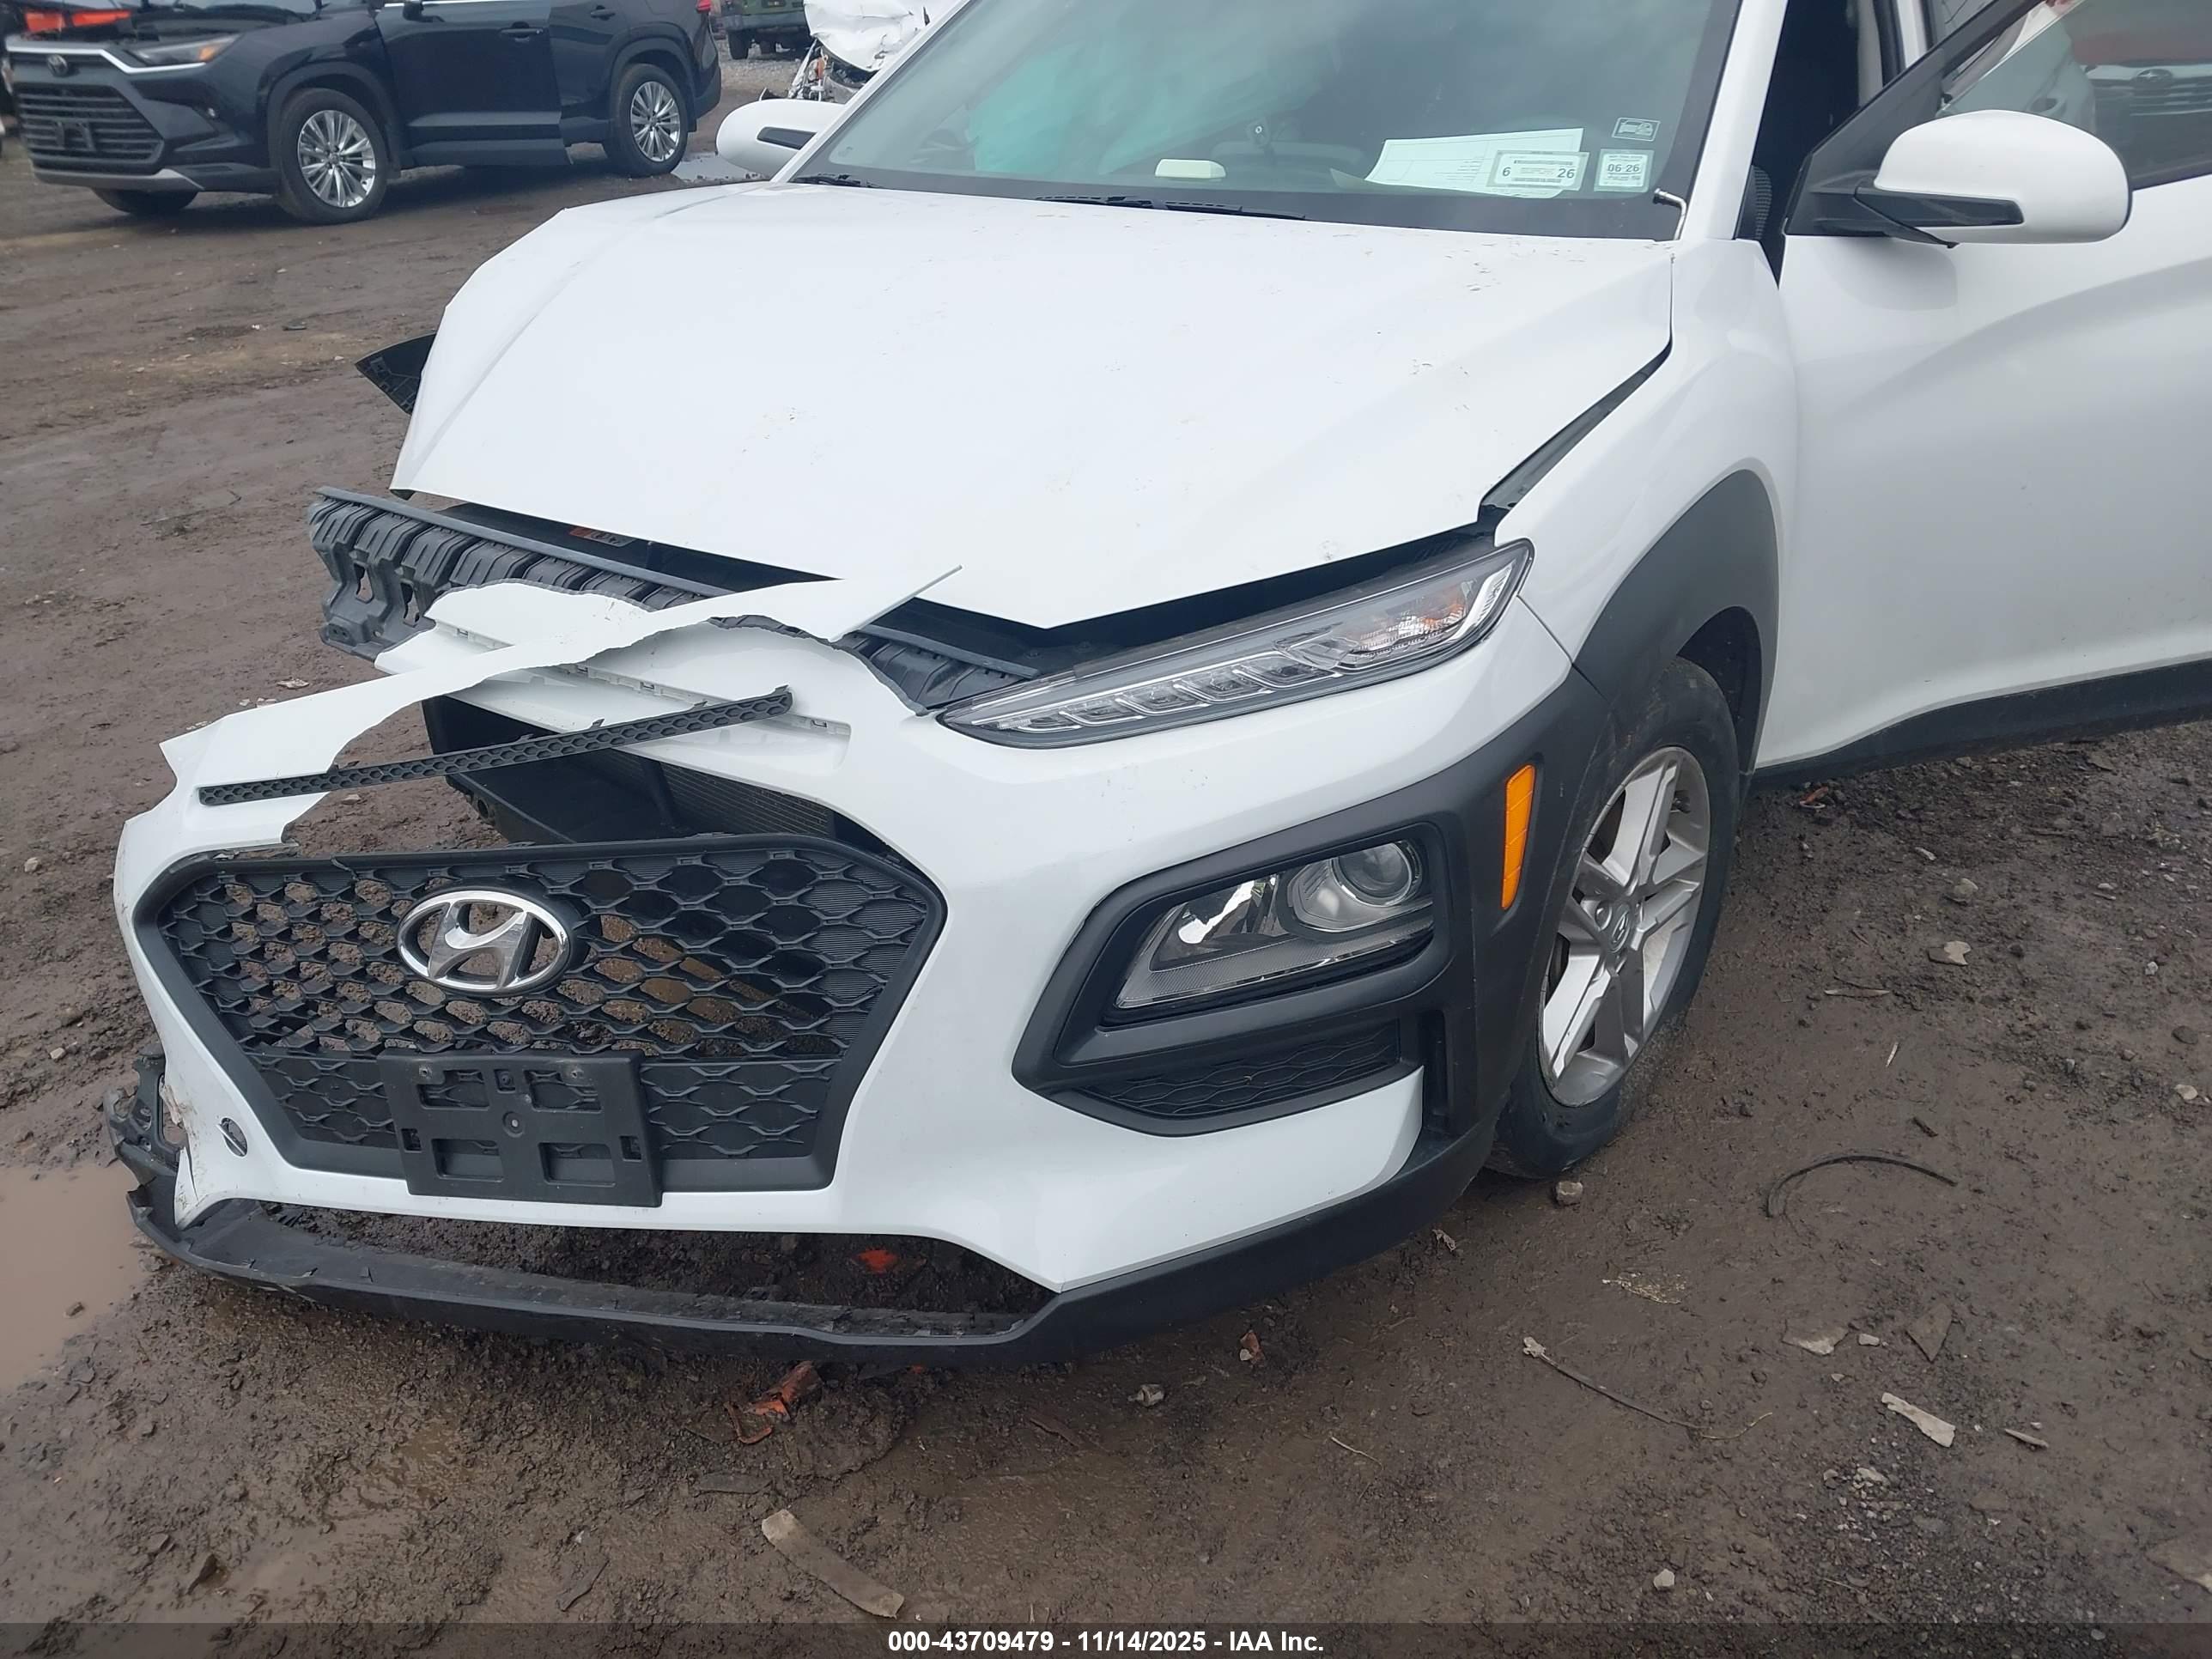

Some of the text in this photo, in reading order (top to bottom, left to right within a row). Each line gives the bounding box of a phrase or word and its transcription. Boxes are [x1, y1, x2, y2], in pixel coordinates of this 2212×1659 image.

[1502, 167, 1511, 177] 6
[1557, 167, 1576, 179] 26
[1607, 164, 1640, 173] 06 26
